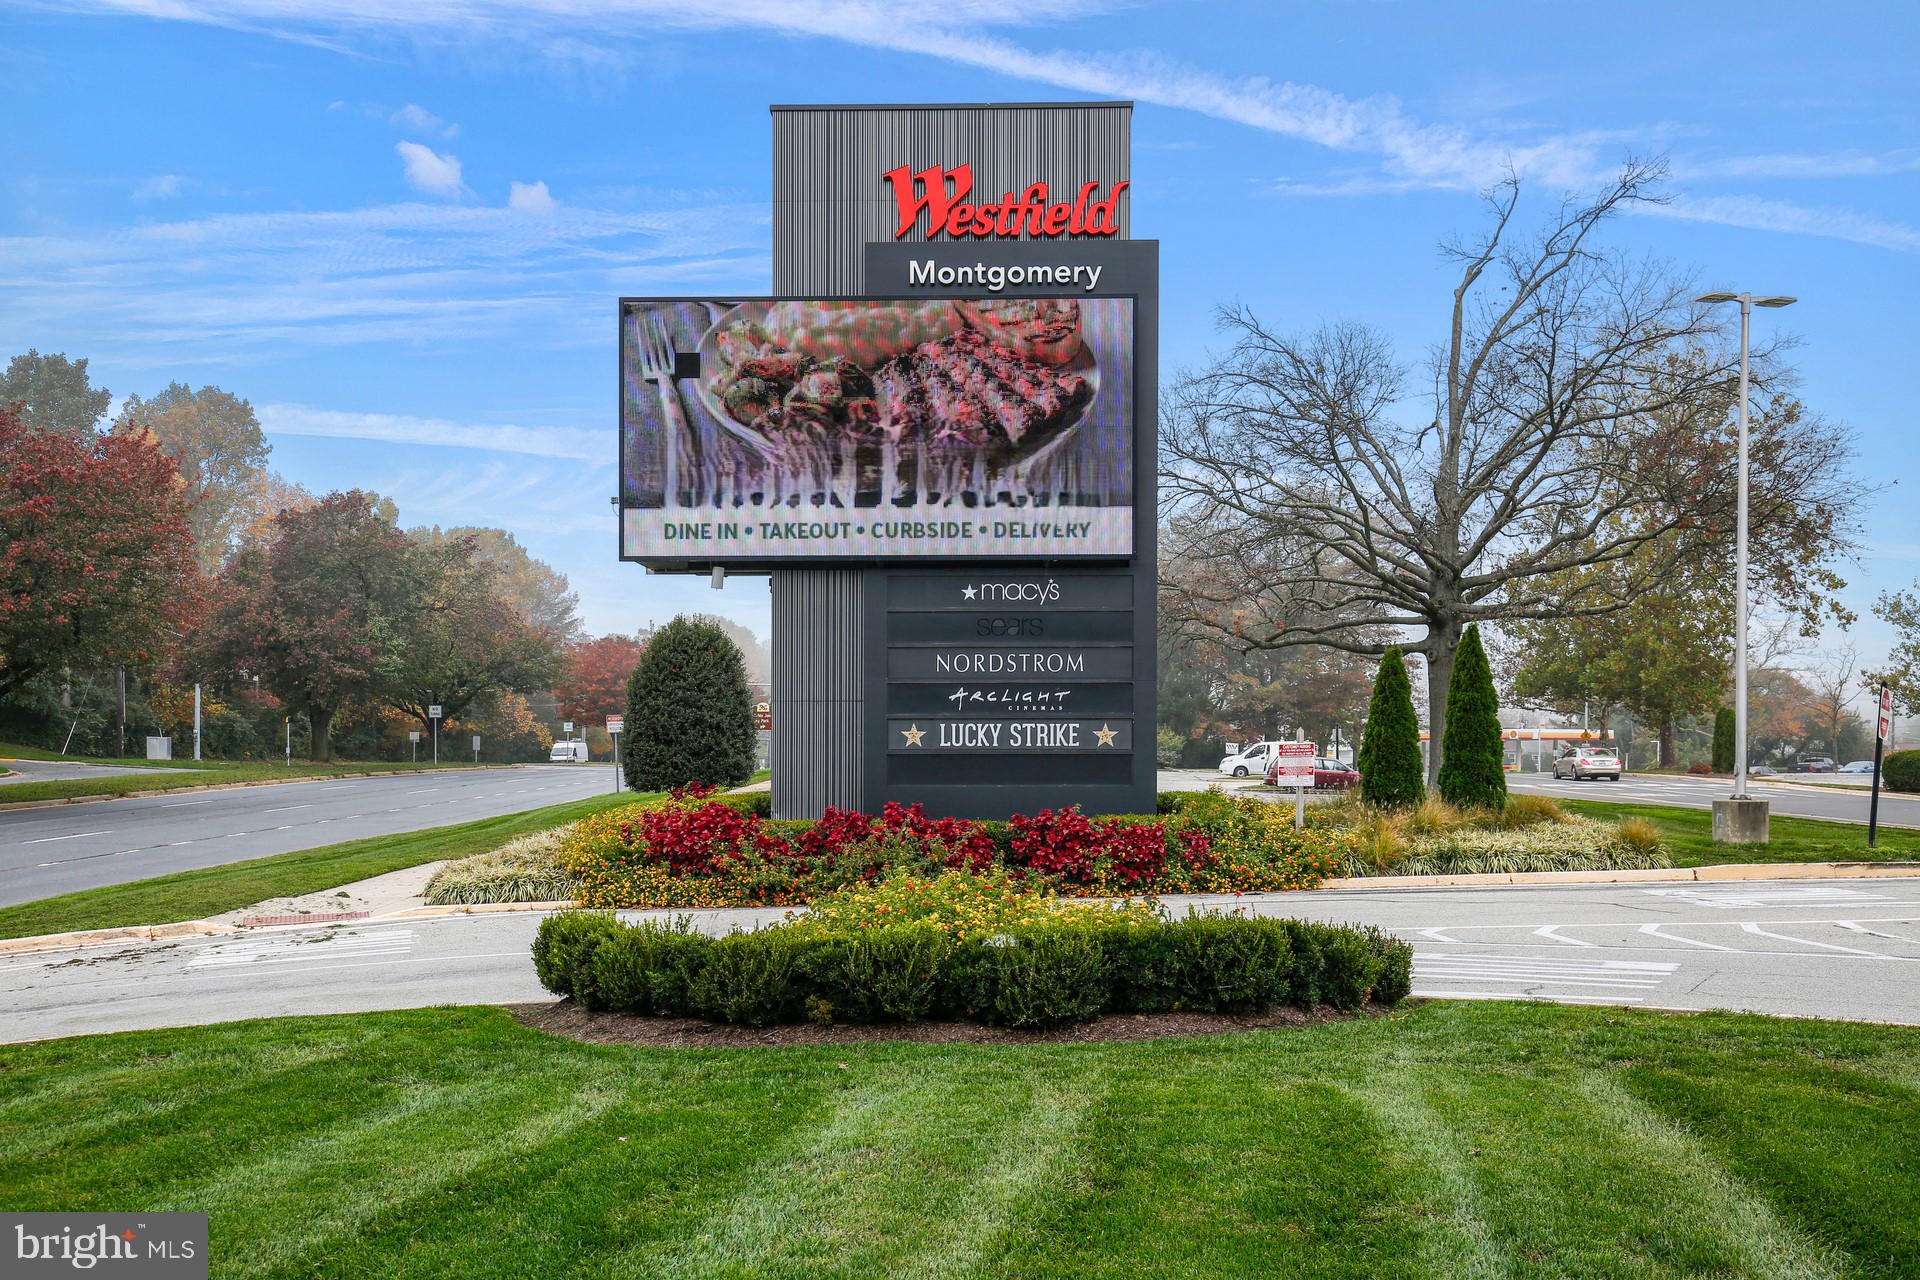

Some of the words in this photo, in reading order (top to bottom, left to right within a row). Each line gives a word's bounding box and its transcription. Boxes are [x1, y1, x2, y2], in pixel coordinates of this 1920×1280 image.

[883, 163, 1130, 238] Westfield
[908, 259, 1103, 292] Montgomery
[663, 522, 712, 540] DINE
[716, 522, 738, 540] IN
[759, 522, 851, 540] TAKEOUT
[871, 521, 973, 539] CURBSIDE
[994, 521, 1092, 539] DELIVERY
[976, 616, 1044, 637] sears
[936, 653, 1084, 673] NORDSTROM
[948, 686, 1071, 711] ARCLIGHT
[939, 723, 1002, 747] LUCKY
[1009, 723, 1080, 747] STRIKE
